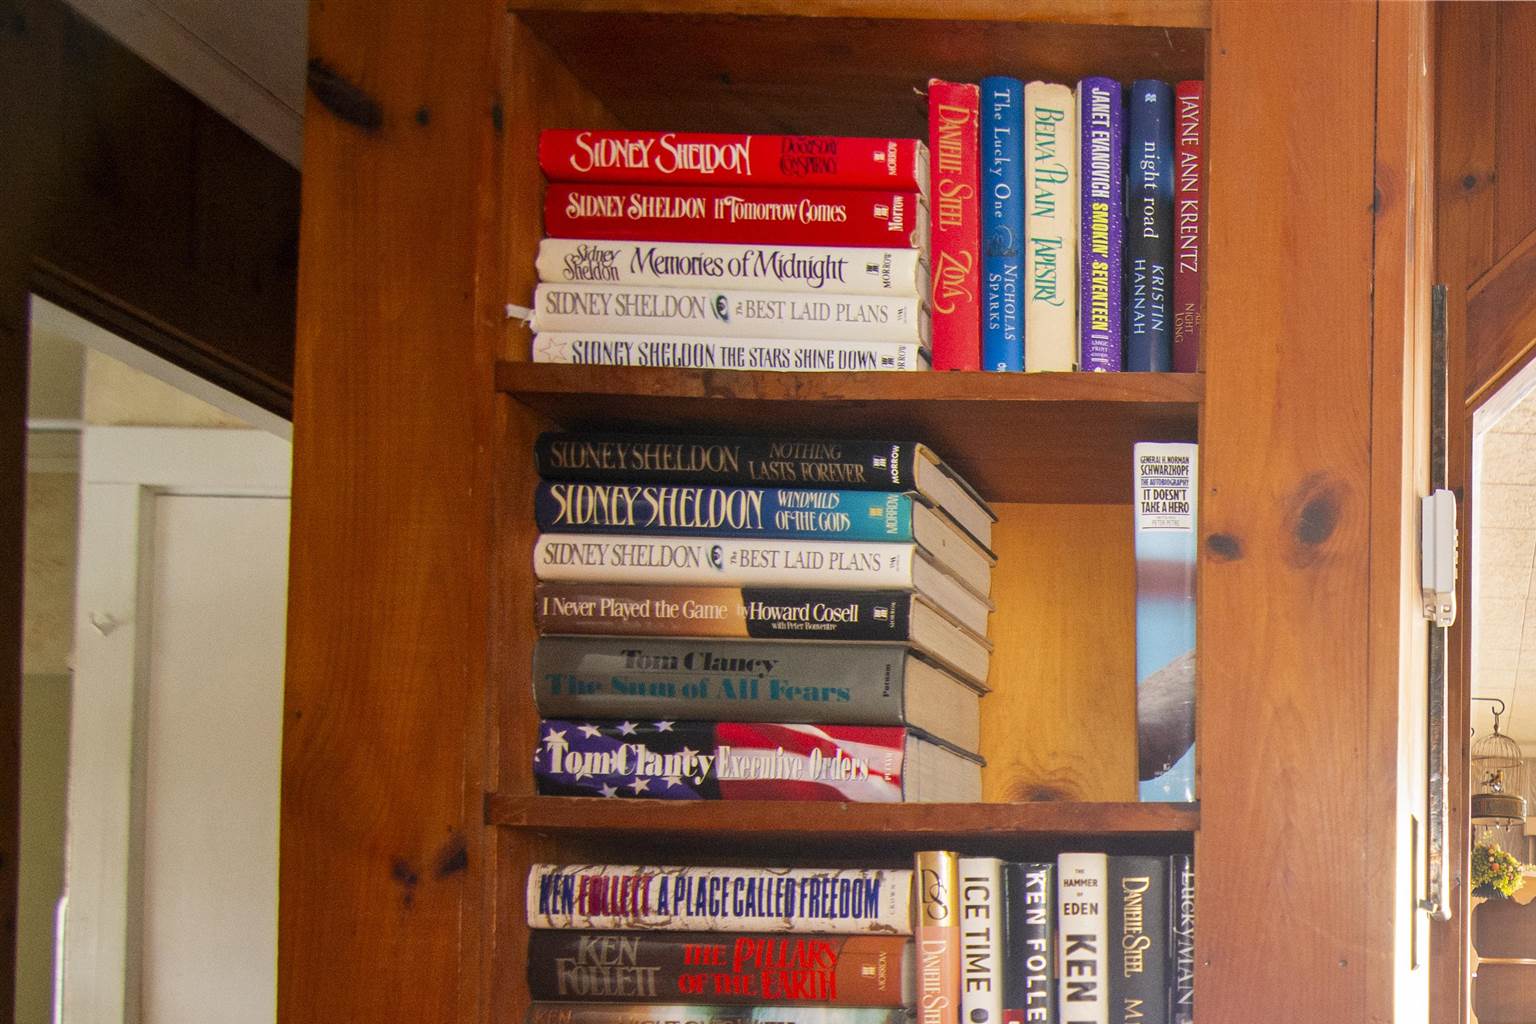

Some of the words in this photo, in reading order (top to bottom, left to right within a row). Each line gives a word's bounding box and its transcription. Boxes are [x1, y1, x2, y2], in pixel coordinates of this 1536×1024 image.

[993, 88, 1011, 121] The
[1091, 87, 1110, 128] JANET
[1179, 96, 1199, 146] JAYNE
[570, 131, 655, 172] SIDNEY
[655, 134, 752, 176] SHELDON
[990, 127, 1011, 177] Lucky
[1034, 106, 1065, 162] BELVA
[1091, 130, 1110, 199] EVANOVICH
[1141, 141, 1160, 190] night
[1181, 152, 1198, 192] ANN
[566, 192, 625, 219] SIDNEY
[627, 193, 706, 220] SHELDON
[723, 196, 797, 223] Tomorrow
[799, 199, 847, 224] Comes
[994, 183, 1011, 219] One
[1032, 163, 1069, 219] PLAIN
[1091, 202, 1110, 258] SMOKIN'
[1143, 198, 1159, 239] road
[1180, 200, 1198, 274] KRENTZ
[630, 247, 723, 278] Memories
[728, 250, 754, 277] of
[752, 250, 848, 289] Midnight
[1030, 235, 1065, 307] TAPESTRY
[546, 291, 613, 316] SIDNEY
[615, 294, 705, 318] SHELDON
[746, 300, 786, 319] BEST
[791, 301, 831, 322] LAID
[835, 304, 888, 323] PLANS
[989, 273, 1000, 331] SPARKS
[1003, 264, 1018, 341] NICHOLAS
[1091, 259, 1109, 332] SEVENTEEN
[1134, 260, 1146, 334] HANNAH
[1151, 265, 1164, 331] KRISTIN
[1184, 303, 1195, 334] NIGHT
[572, 341, 633, 366] SIDNEY
[638, 342, 715, 368] SHELDON
[720, 346, 746, 368] THE
[749, 347, 791, 369] STARS
[794, 349, 834, 370] SHINE
[839, 350, 878, 370] DOWN
[551, 441, 624, 470] SIDNEY
[631, 444, 741, 473] SHELDON
[769, 441, 842, 461] NOTHING
[891, 444, 901, 484] MORROW
[749, 461, 797, 481] LASTS
[801, 463, 866, 483] FOREVER
[551, 484, 641, 526] SIDNEY
[641, 485, 765, 530] SHELDON
[1141, 502, 1160, 513] TAKE
[1168, 502, 1189, 513] HERO
[1143, 489, 1151, 500] IT
[1153, 489, 1186, 500] DOESN'T
[543, 543, 610, 567] SIDNEY
[611, 545, 701, 569] SHELDON
[740, 550, 780, 569] BEST
[783, 551, 824, 569] LAID
[828, 552, 882, 572] PLANS
[552, 598, 596, 617] Never
[599, 597, 650, 622] Played
[654, 600, 680, 618] the
[682, 600, 729, 619] Game
[749, 601, 810, 622] Howard
[812, 602, 859, 623] Cosell
[622, 649, 680, 672] Tom
[684, 651, 779, 678] Clancy
[545, 674, 600, 695] The
[612, 675, 677, 697] Sum
[682, 677, 709, 699] of
[713, 675, 760, 700] All
[769, 678, 850, 702] Fears
[539, 874, 574, 914] KEN
[578, 874, 652, 917] FOLLETT
[657, 875, 670, 916] A
[673, 876, 730, 917] PLACE
[733, 877, 795, 918] CALLED
[799, 878, 880, 919] FREEDOM
[1025, 869, 1047, 924] KEN
[1063, 879, 1099, 888] HAMMER
[1063, 903, 1099, 915] EDEN
[577, 936, 641, 965] KEN
[1066, 934, 1097, 1002] KEN
[678, 976, 710, 995] OF
[715, 974, 758, 996] THE
[761, 970, 838, 1000] EARTH
